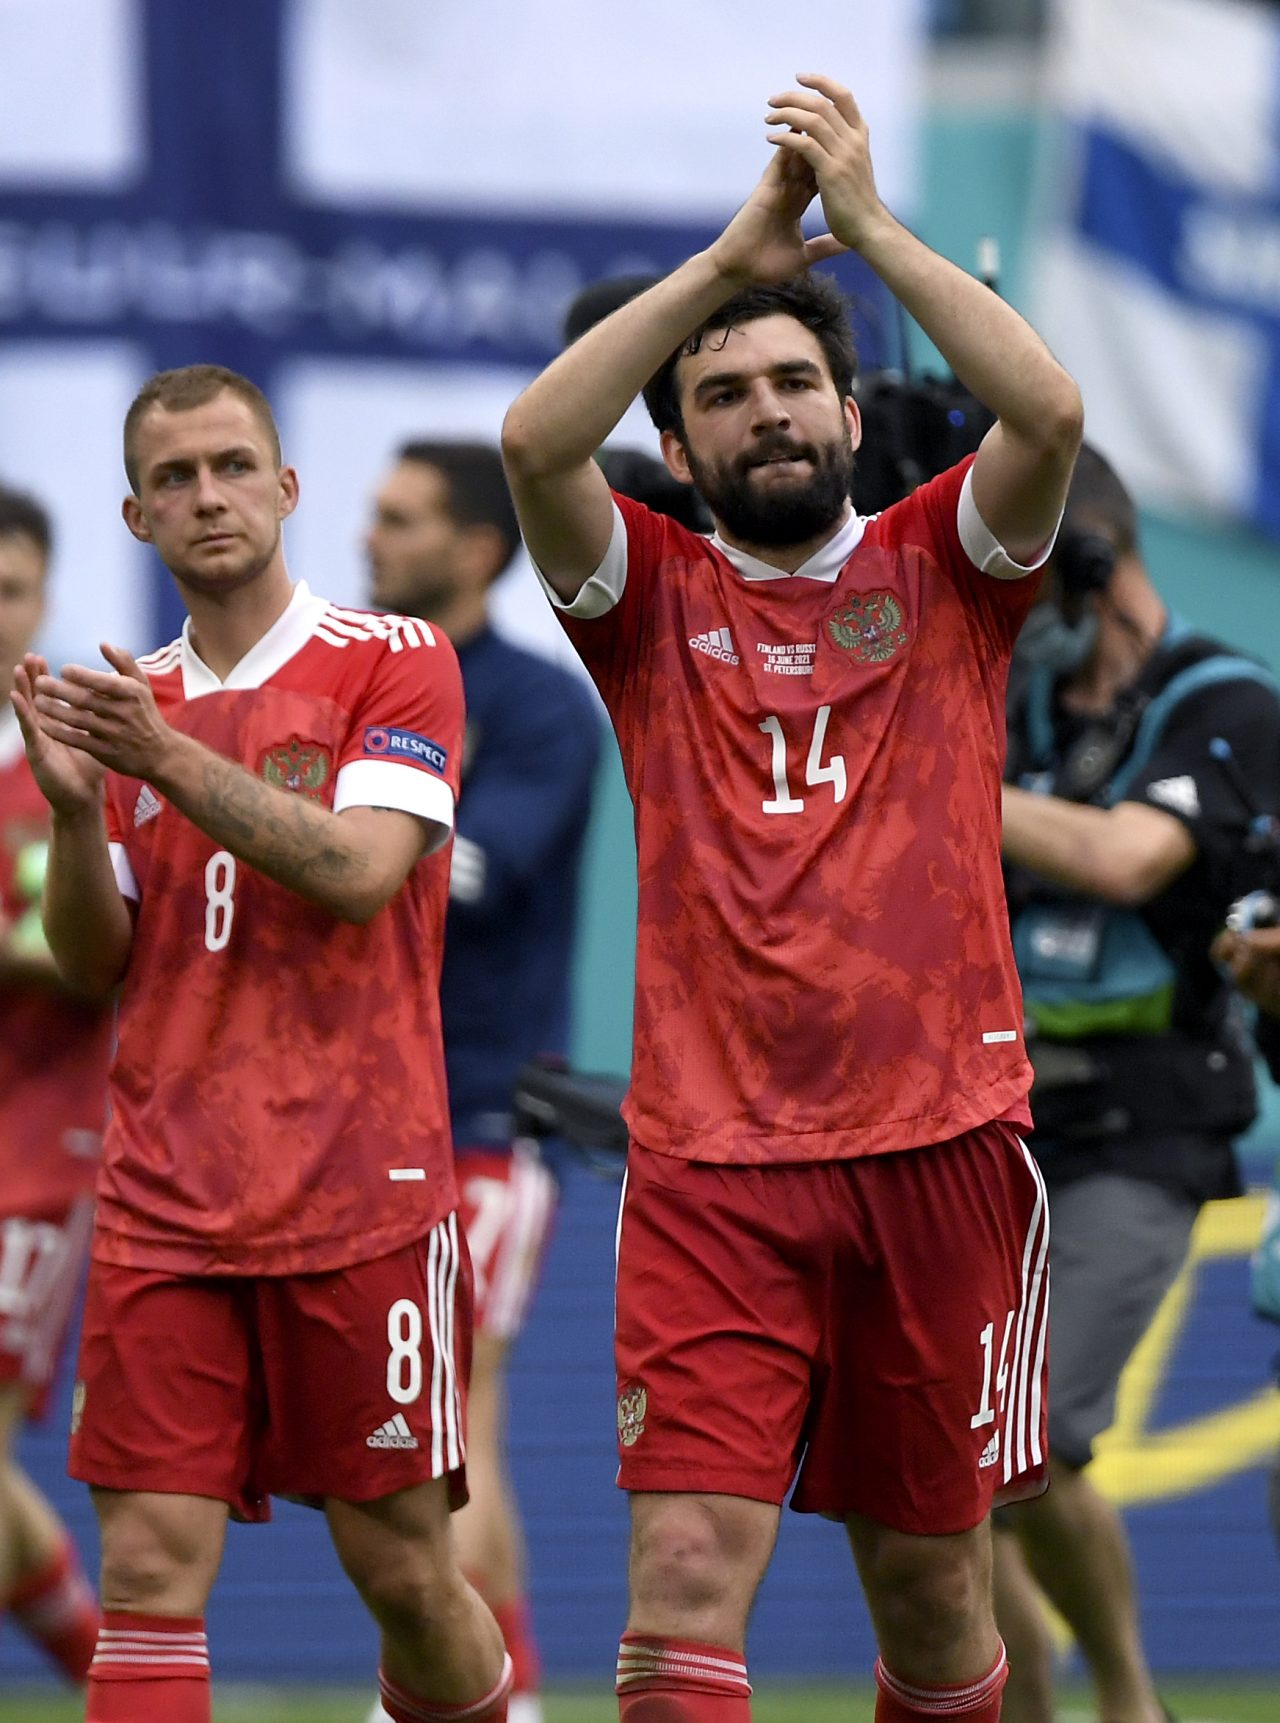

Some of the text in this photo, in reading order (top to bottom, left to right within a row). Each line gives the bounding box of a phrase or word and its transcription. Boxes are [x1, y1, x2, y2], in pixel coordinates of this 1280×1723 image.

[688, 637, 739, 666] adidas
[757, 643, 786, 655] FINLAND
[786, 644, 795, 654] VS
[767, 654, 810, 665] 16 JUNE 2021
[390, 735, 446, 769] RESPECT
[758, 704, 847, 814] 14
[205, 850, 237, 953] 8
[386, 1298, 423, 1405] 8
[970, 1309, 1016, 1430] 14
[366, 1435, 418, 1450] adidas
